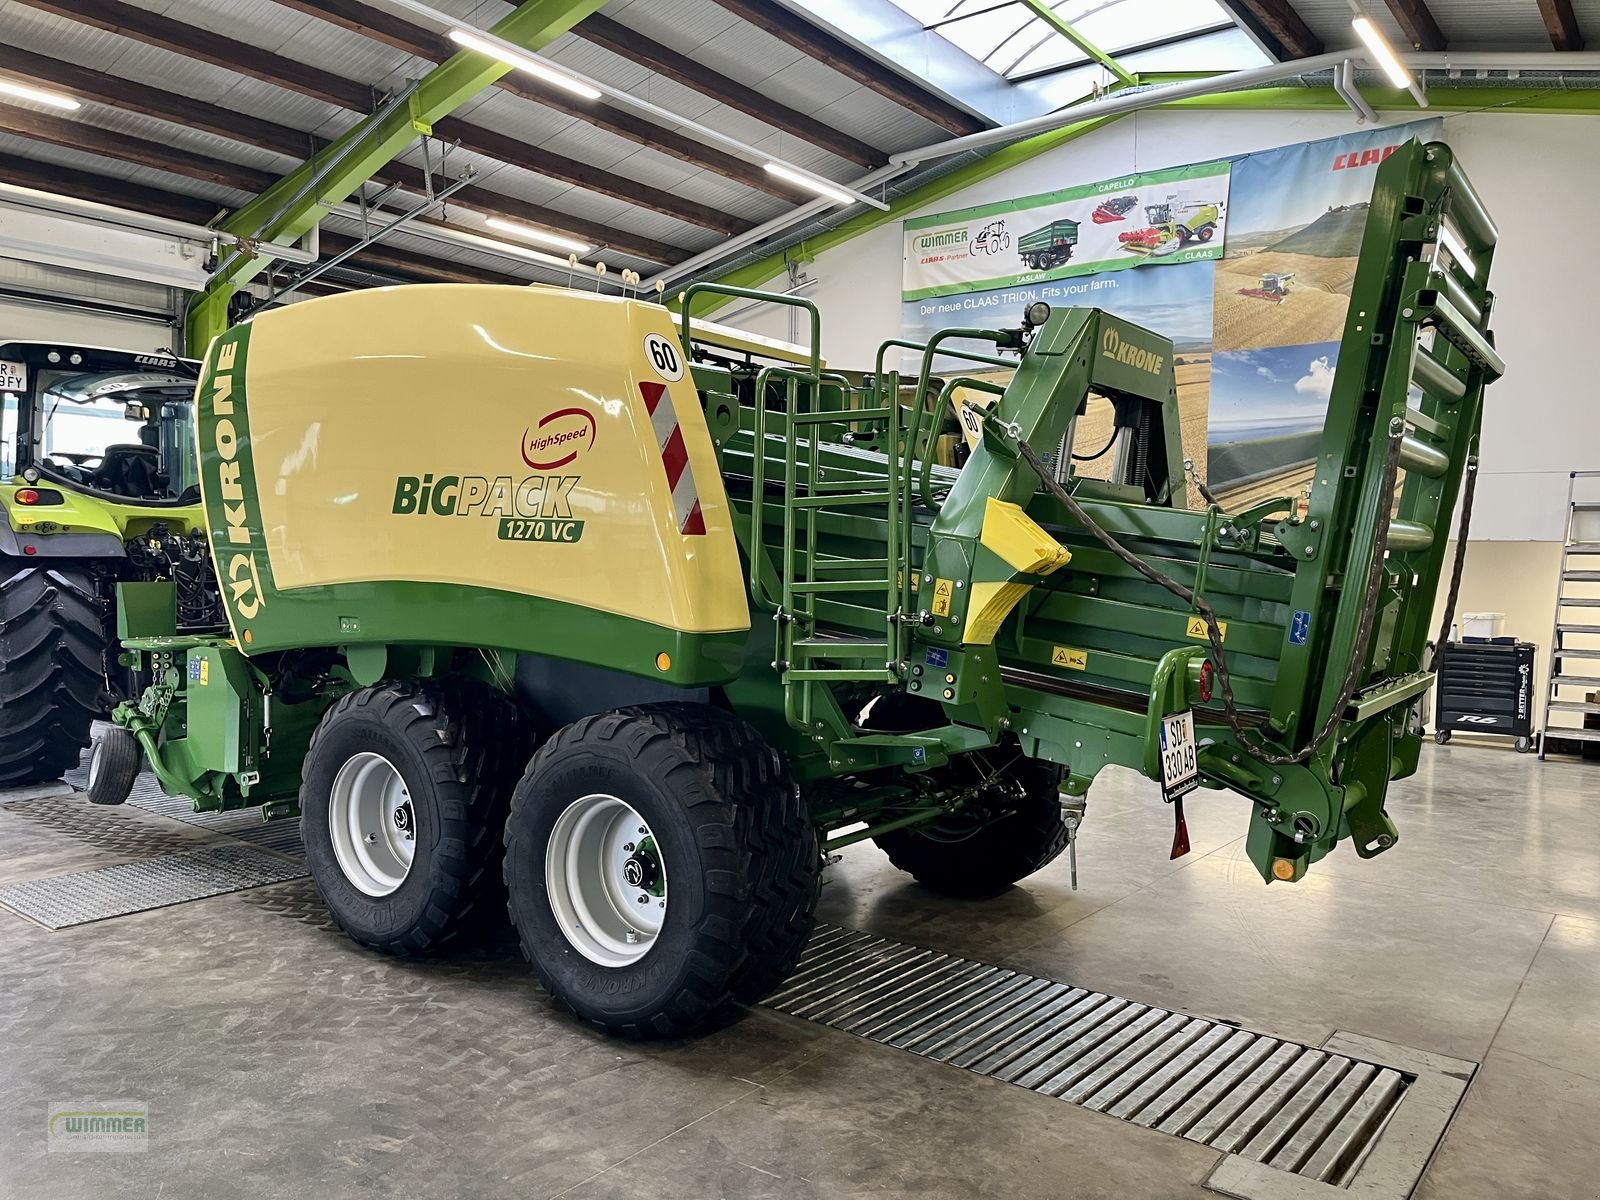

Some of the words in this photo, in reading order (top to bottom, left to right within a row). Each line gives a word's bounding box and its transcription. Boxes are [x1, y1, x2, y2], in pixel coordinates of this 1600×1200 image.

[1098, 178, 1135, 192] CAPELLO
[920, 230, 968, 249] WIMMER
[1185, 250, 1213, 260] CLAAS
[1016, 273, 1046, 284] ZASLAW
[920, 305, 937, 316] Der
[938, 302, 961, 313] neue
[963, 295, 999, 309] CLAAS
[1001, 290, 1038, 304] TRION.
[1041, 287, 1061, 298] Fits
[1063, 284, 1089, 298] your
[1091, 279, 1119, 291] farm.
[134, 355, 177, 368] CLAAS
[649, 339, 678, 373] 60
[1116, 341, 1164, 376] KRONE
[962, 409, 979, 433] 60
[212, 340, 252, 545] KRONE
[529, 424, 588, 451] HighSpeed
[506, 520, 546, 540] 1270
[551, 521, 576, 542] VC
[1170, 719, 1183, 748] SD
[1165, 749, 1183, 781] 330
[1184, 745, 1195, 775] AB
